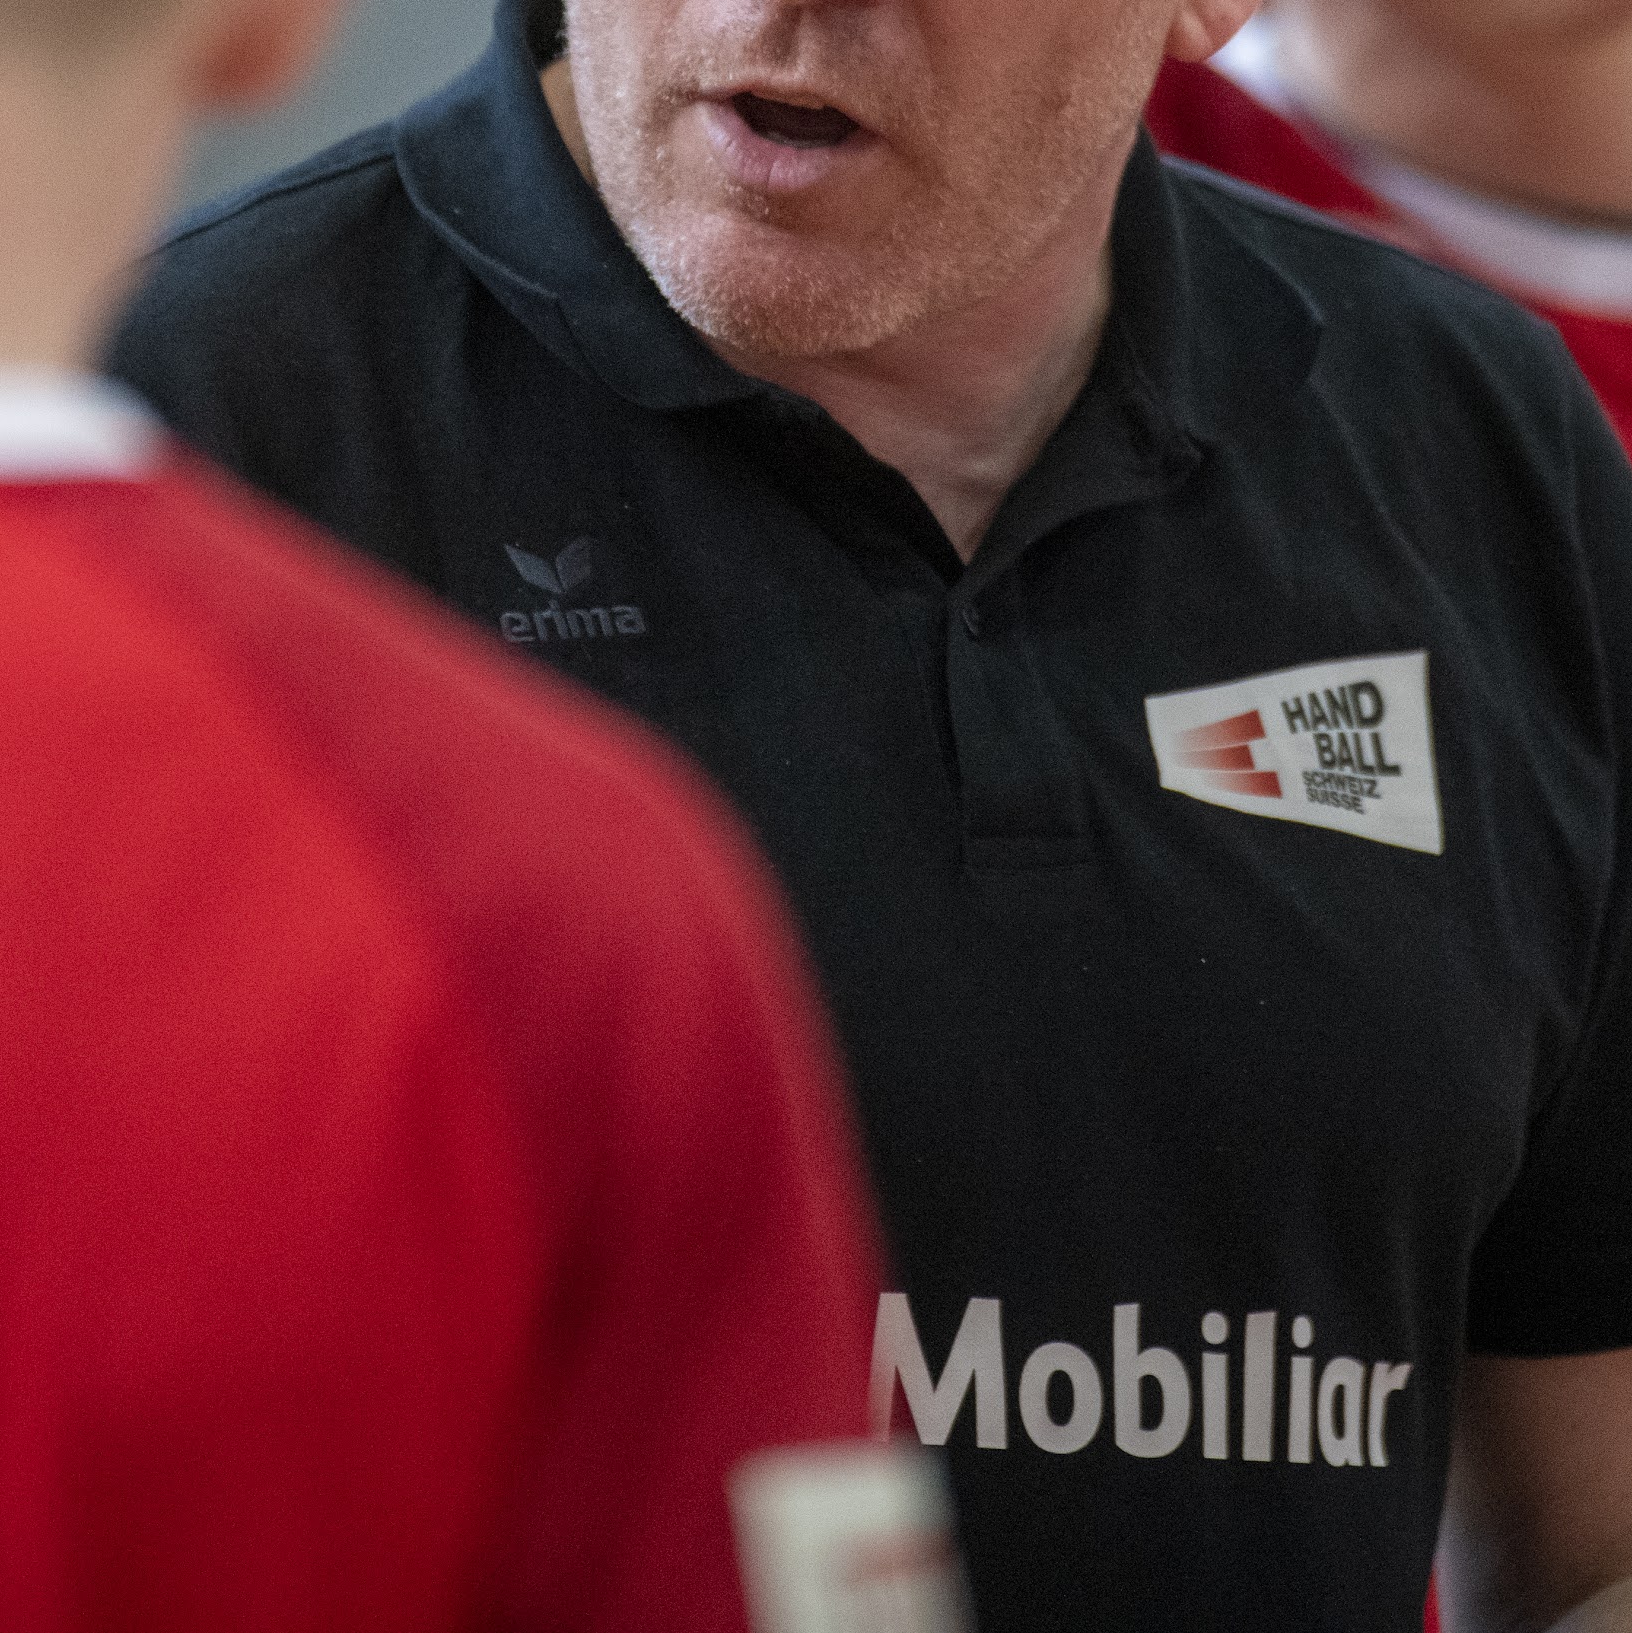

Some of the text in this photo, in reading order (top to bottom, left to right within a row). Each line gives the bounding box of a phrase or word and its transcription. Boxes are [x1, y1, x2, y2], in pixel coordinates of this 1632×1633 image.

[499, 599, 647, 642] erima
[1281, 680, 1385, 735] HAND
[1313, 731, 1402, 777] BALL
[869, 1292, 1414, 1467] Mobiliar
